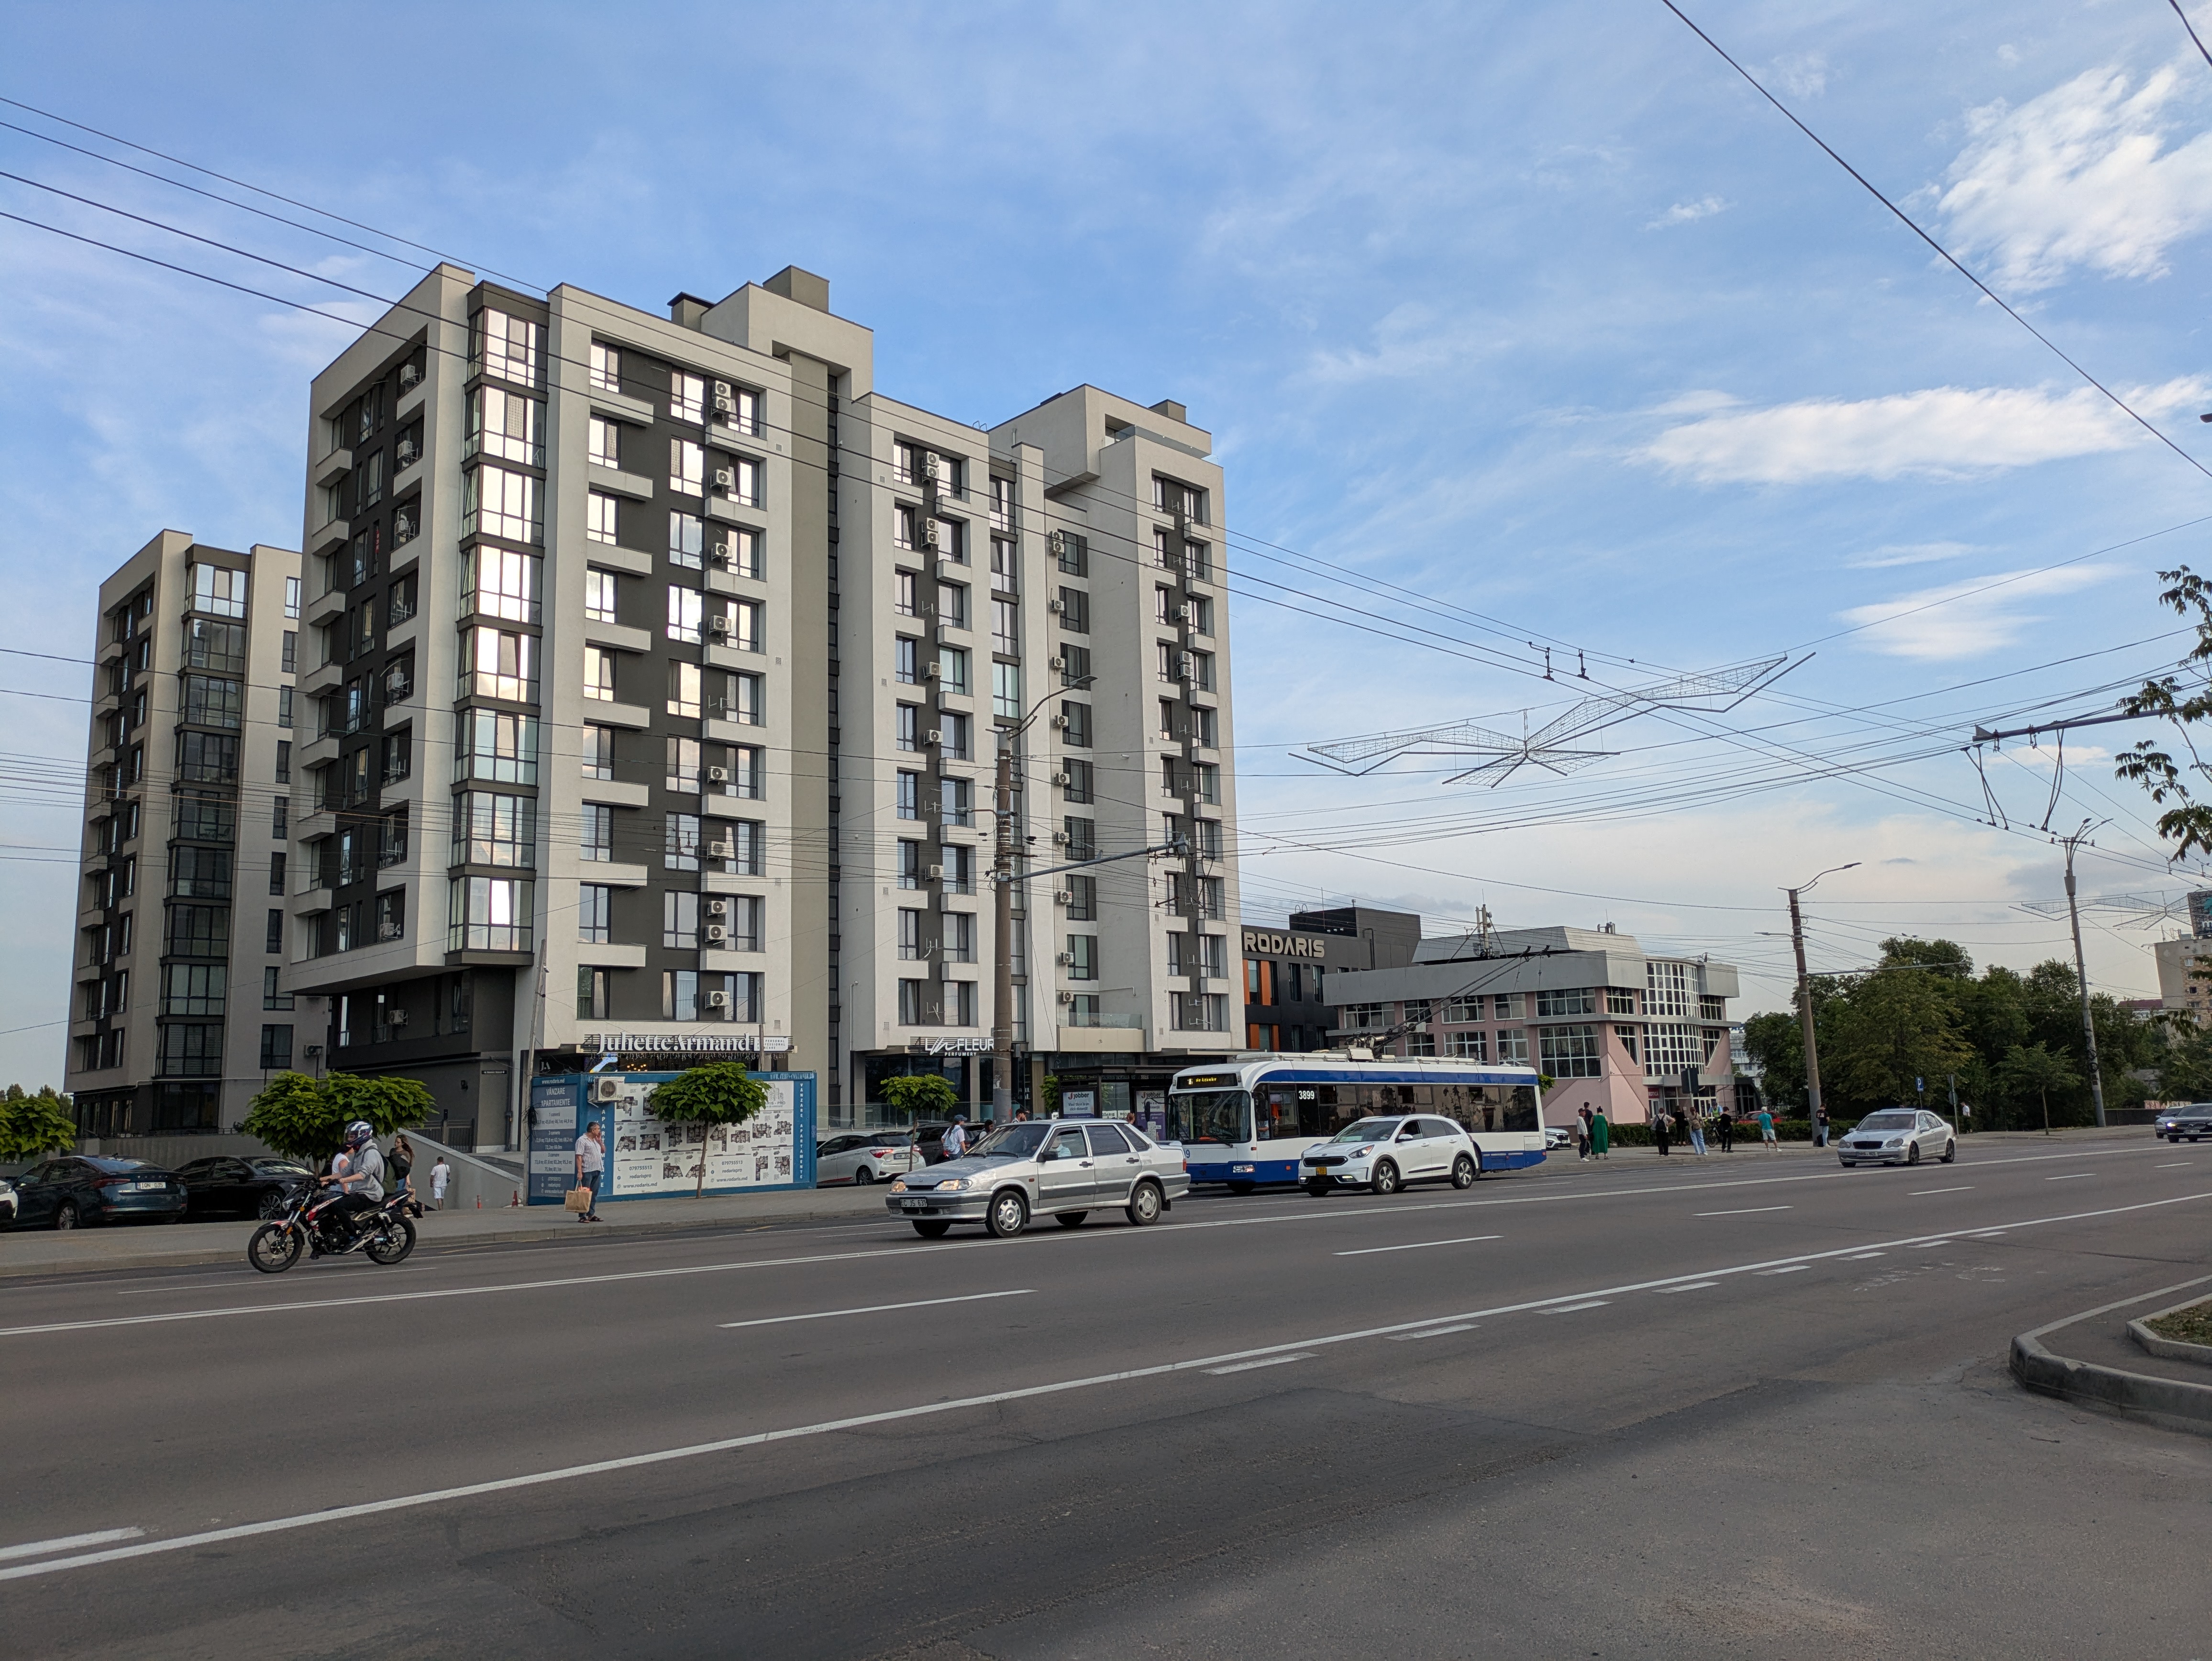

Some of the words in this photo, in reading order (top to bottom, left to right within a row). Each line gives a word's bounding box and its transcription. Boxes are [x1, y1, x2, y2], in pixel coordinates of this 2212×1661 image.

[1244, 932, 1325, 958] RODARIS
[599, 1032, 671, 1053] Juliette
[674, 1032, 750, 1052] Armand
[541, 1098, 570, 1107] APARTAMENTE
[1299, 1091, 1315, 1100] 3899
